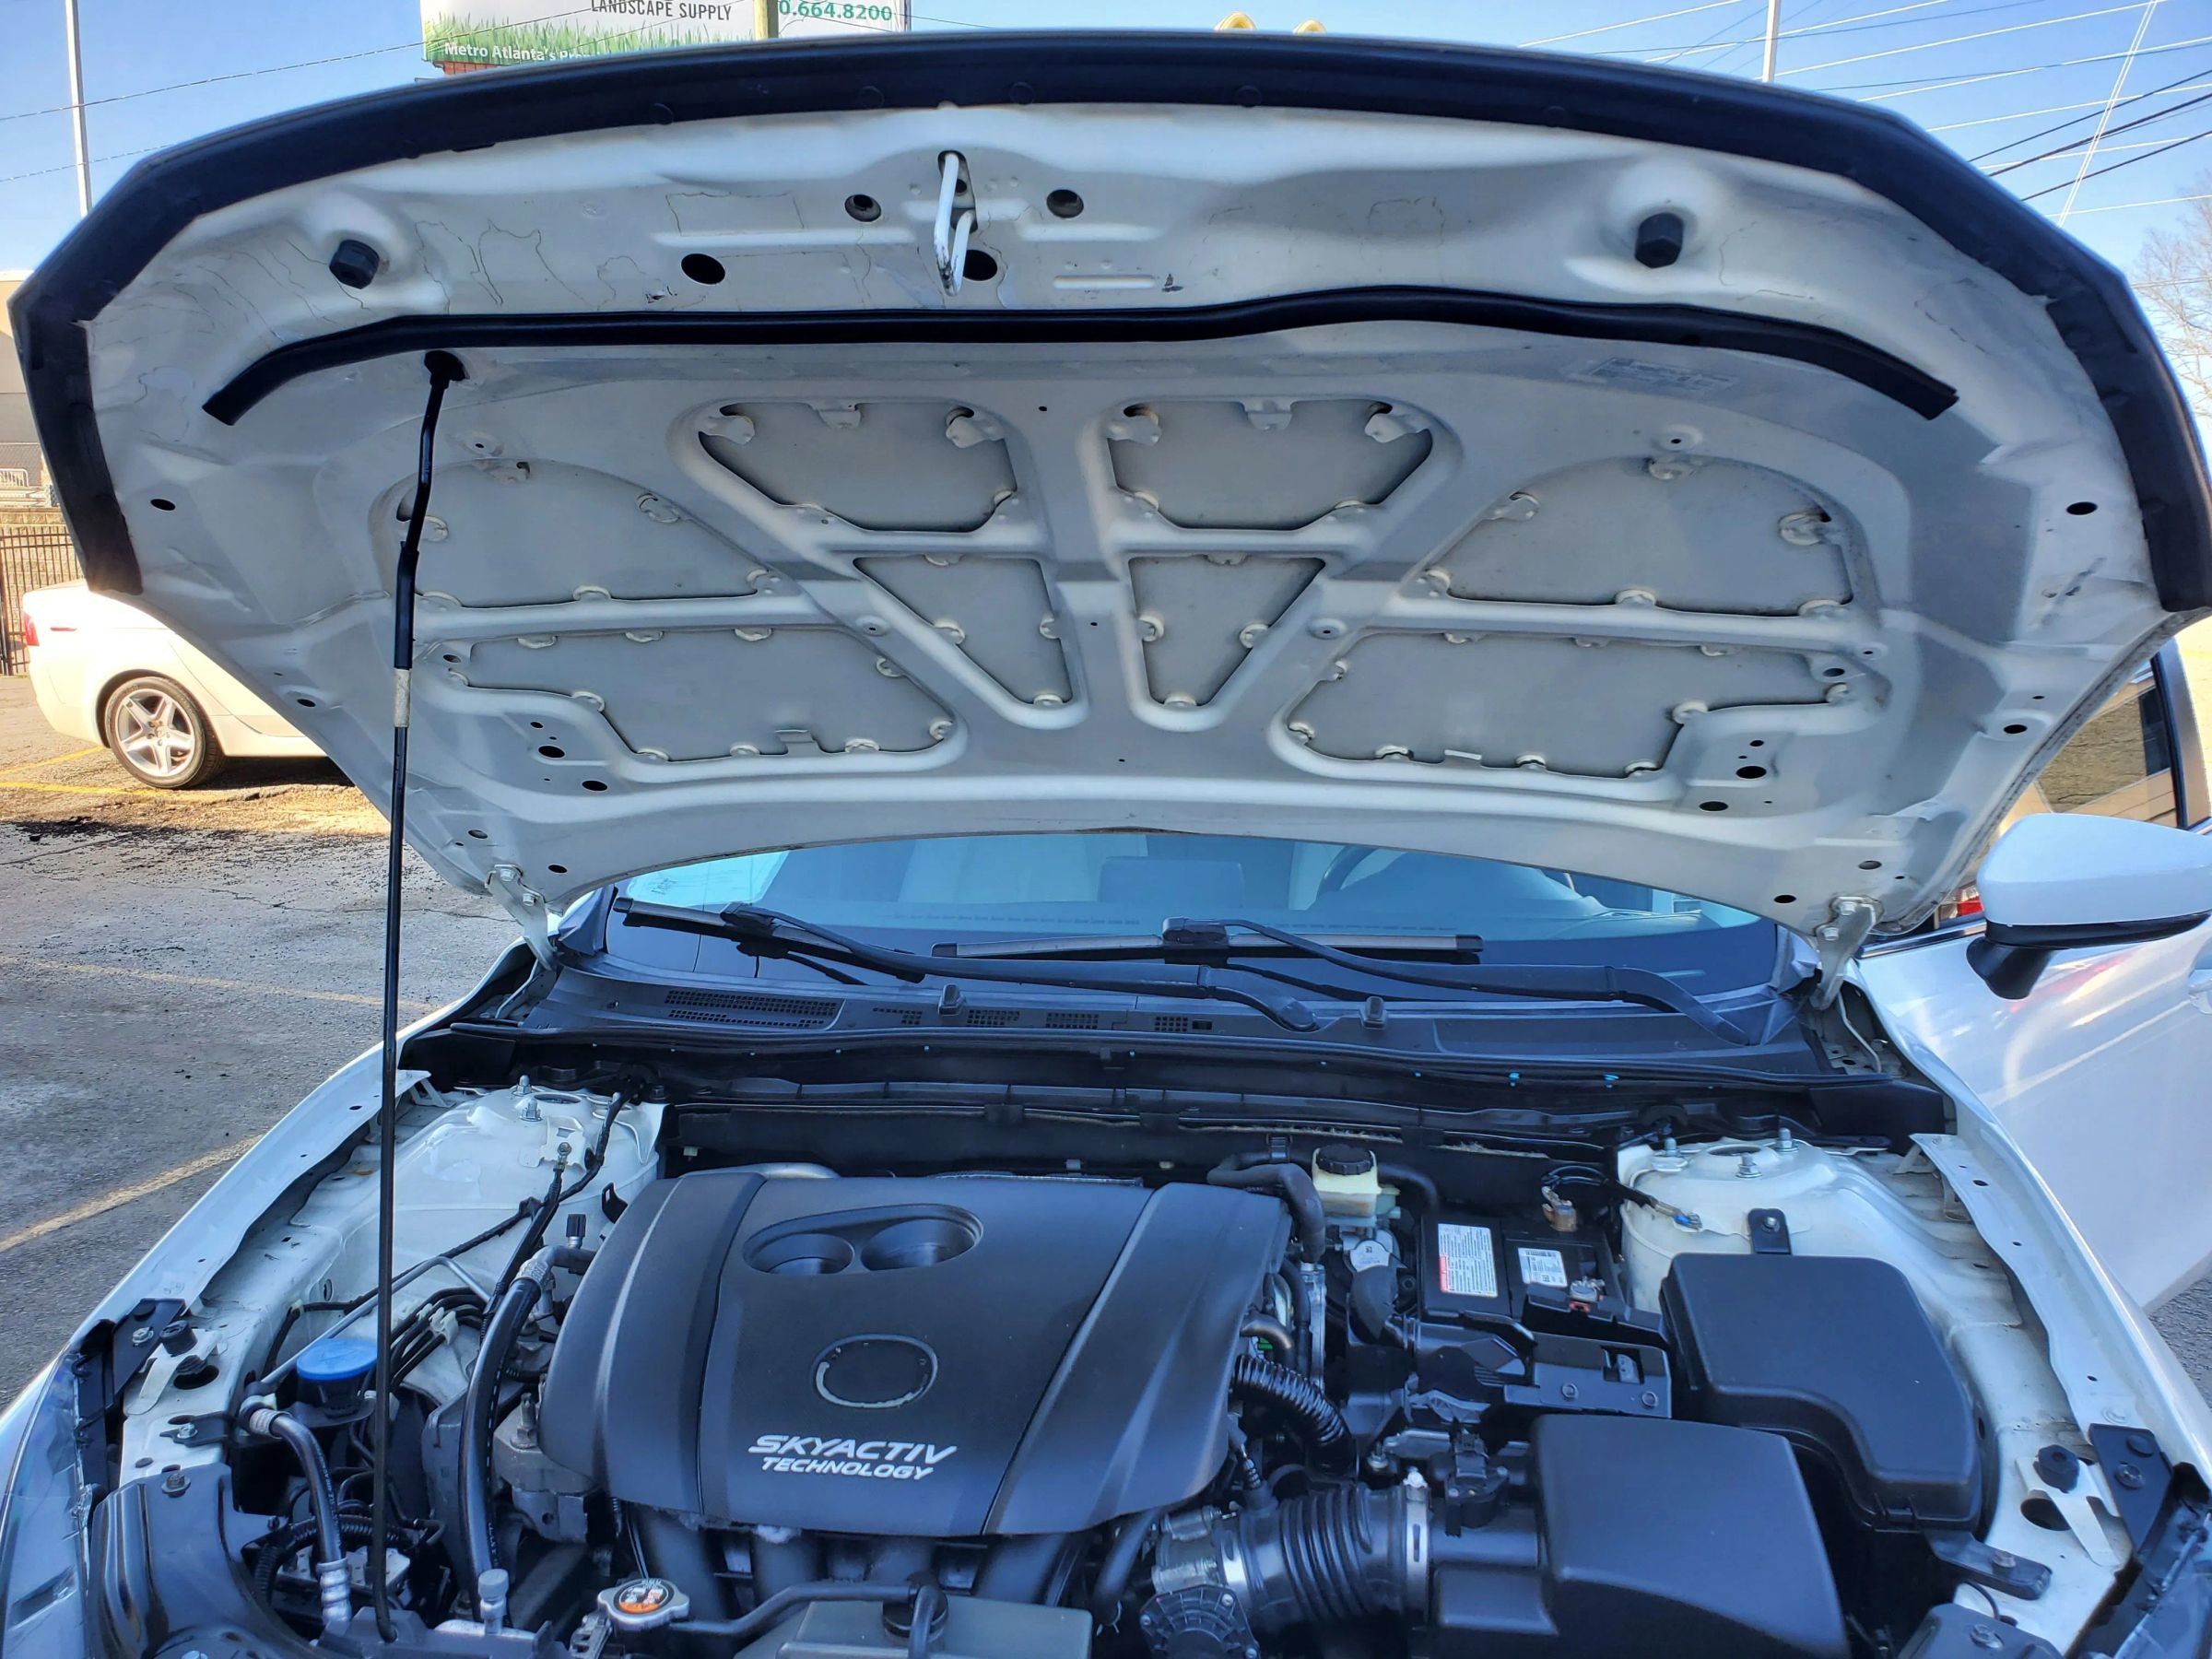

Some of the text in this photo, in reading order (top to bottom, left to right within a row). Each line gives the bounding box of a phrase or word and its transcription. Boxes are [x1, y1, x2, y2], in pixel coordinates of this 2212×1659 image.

[592, 0, 732, 20] LANDSCAPE SUPPLY
[444, 42, 488, 57] Metro
[492, 46, 556, 61] Atlanta's
[748, 1435, 957, 1464] SKYACTIV
[762, 1457, 934, 1480] TECHNOLOGY
